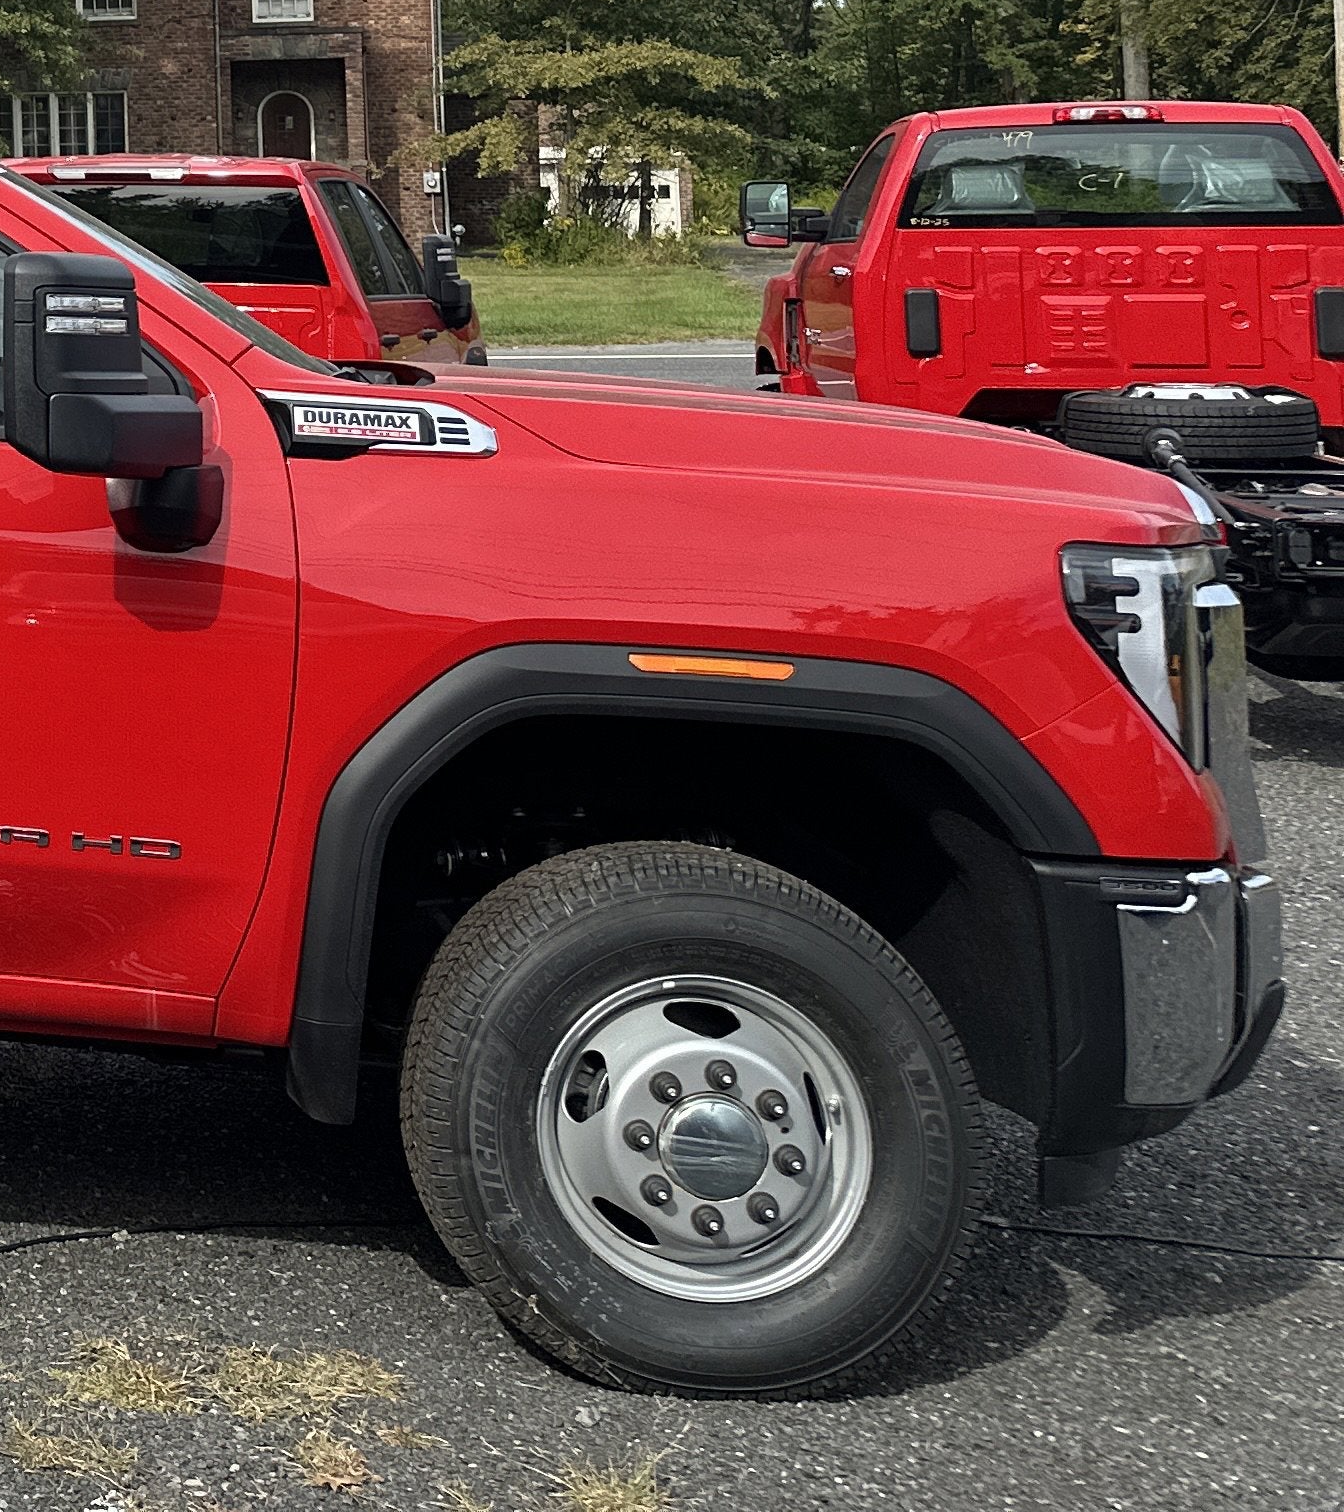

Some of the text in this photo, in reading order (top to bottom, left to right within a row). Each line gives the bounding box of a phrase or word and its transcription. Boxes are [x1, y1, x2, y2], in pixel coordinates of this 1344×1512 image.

[1002, 130, 1033, 150] 479
[302, 409, 412, 429] DURAMAX
[71, 830, 182, 860] HD
